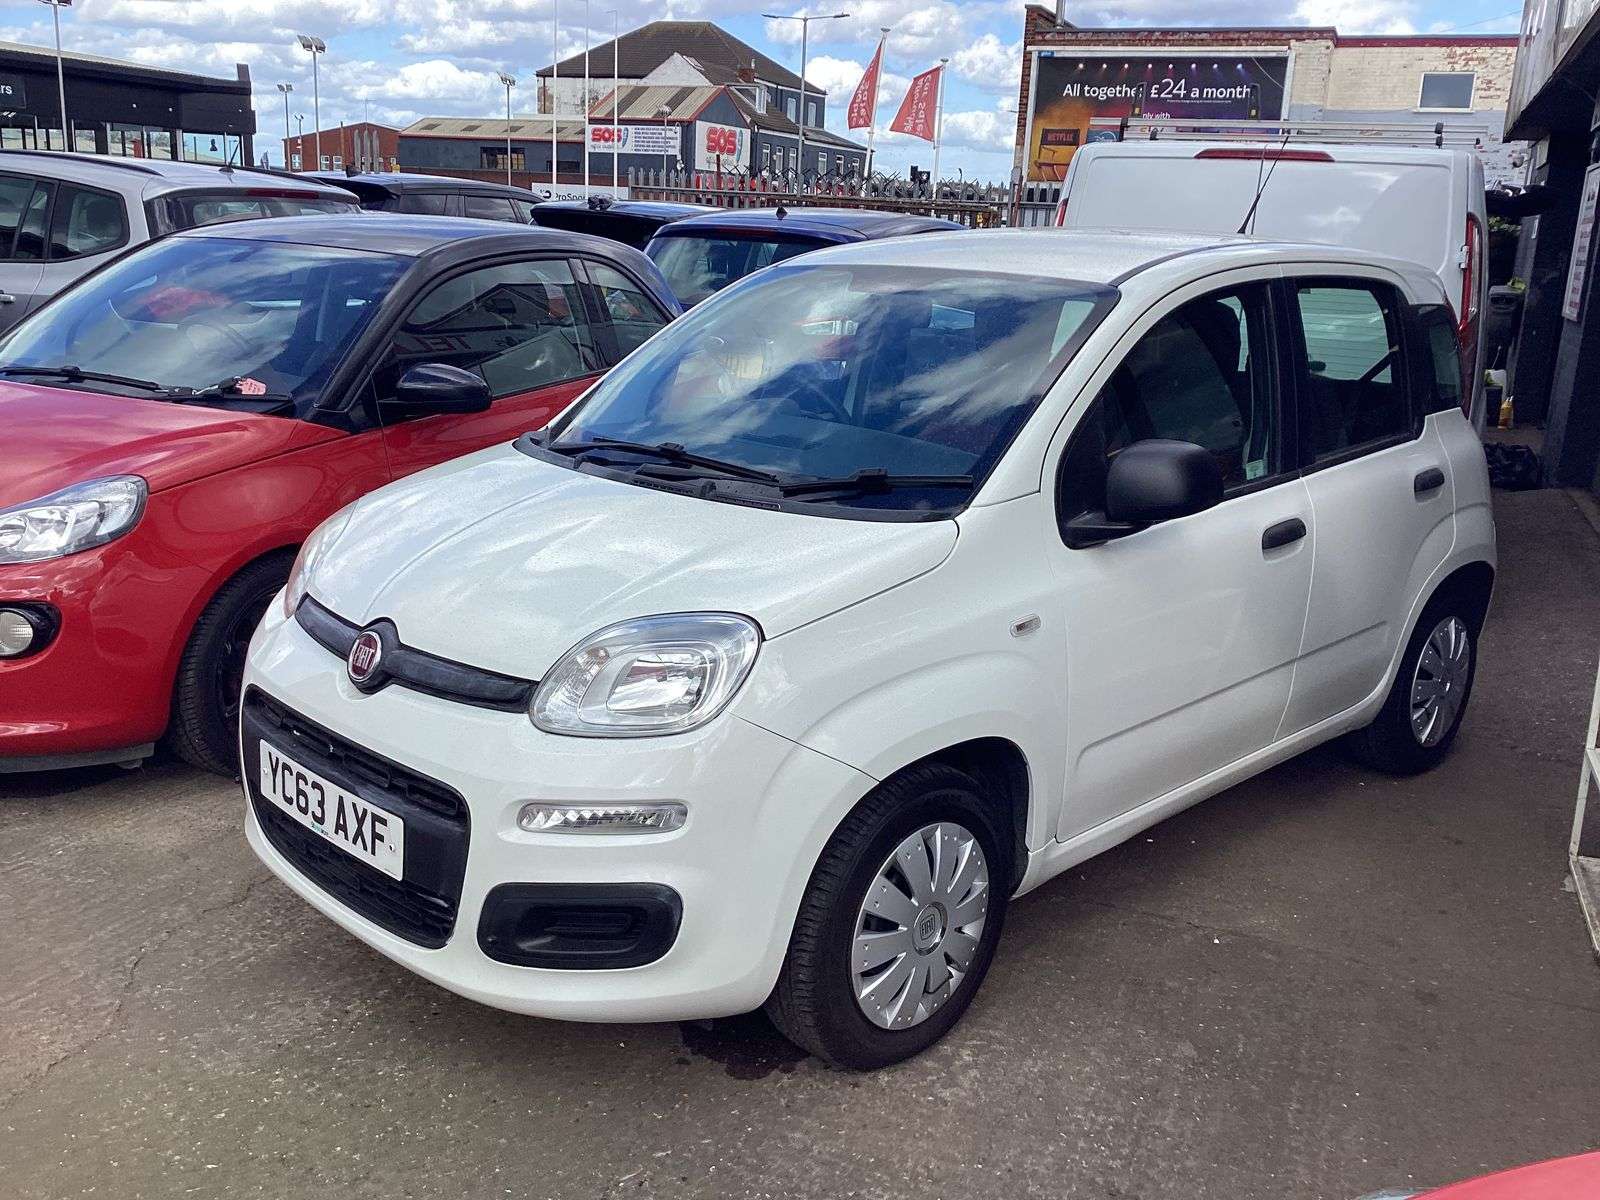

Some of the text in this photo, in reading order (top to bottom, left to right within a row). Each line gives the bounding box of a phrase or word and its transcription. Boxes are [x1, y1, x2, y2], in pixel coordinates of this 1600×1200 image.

[0, 85, 12, 95] rs
[1063, 83, 1081, 97] All
[1150, 78, 1187, 98] £24
[1190, 87, 1200, 98] a
[590, 127, 623, 143] SOS
[705, 126, 737, 156] SOS
[353, 644, 375, 670] FIAT
[268, 751, 388, 857] YC63 AXF
